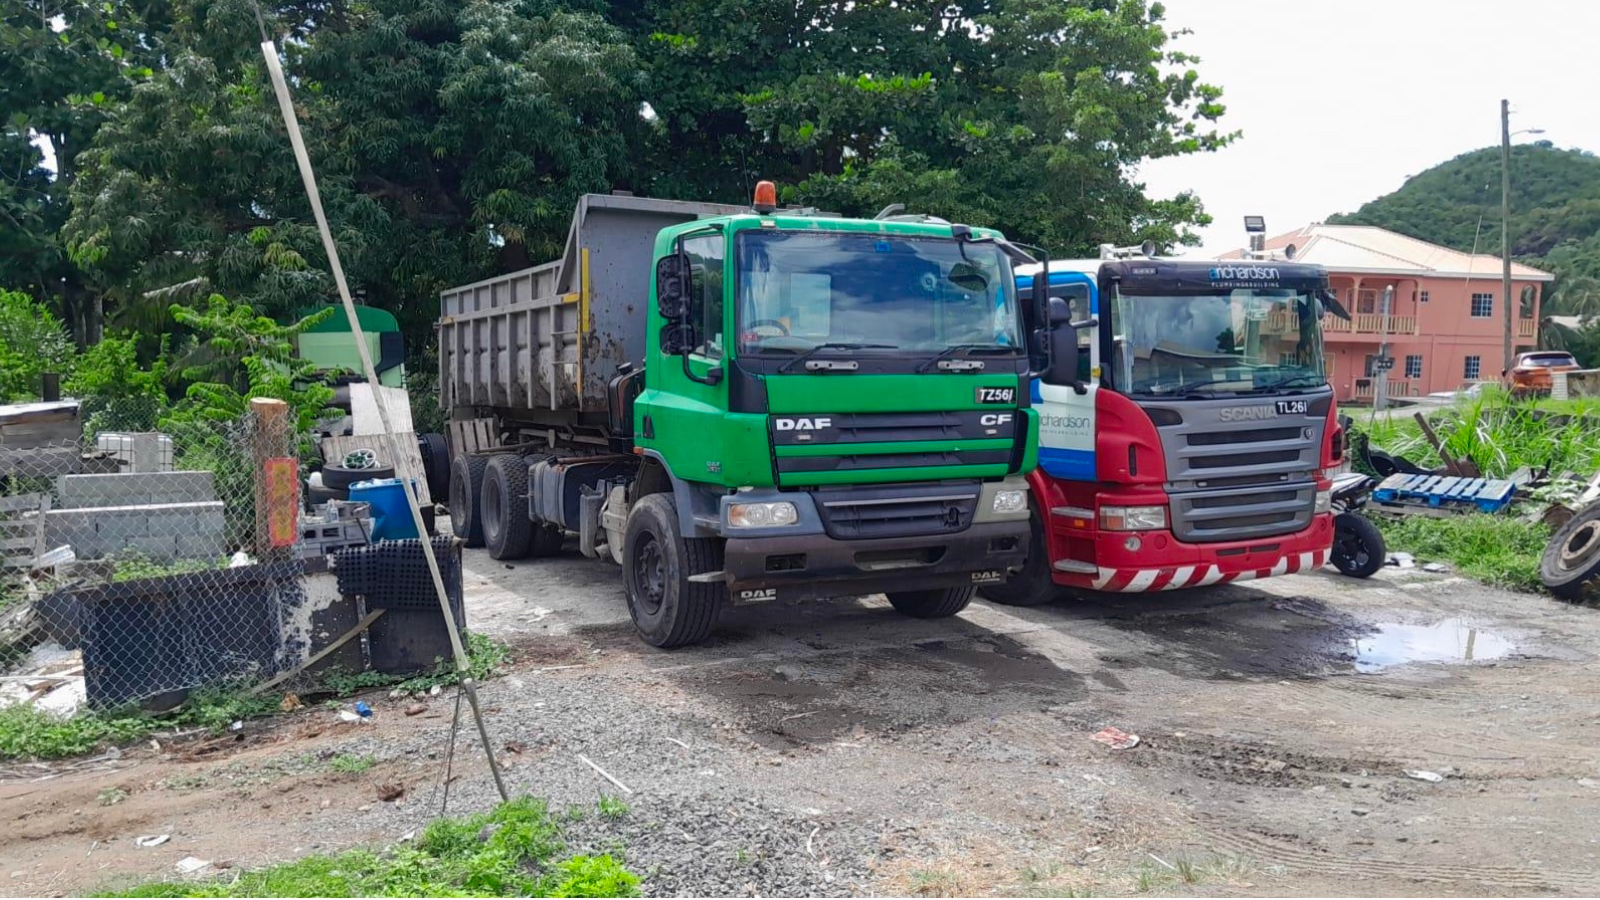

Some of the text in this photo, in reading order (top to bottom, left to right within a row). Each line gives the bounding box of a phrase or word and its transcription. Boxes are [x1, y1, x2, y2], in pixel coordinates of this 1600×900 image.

[1220, 404, 1278, 422] SCANIA
[775, 418, 832, 430] DAF
[980, 414, 1012, 426] CF
[1038, 412, 1090, 429] chardson
[971, 570, 1000, 579] DAF
[741, 588, 777, 599] DAF
